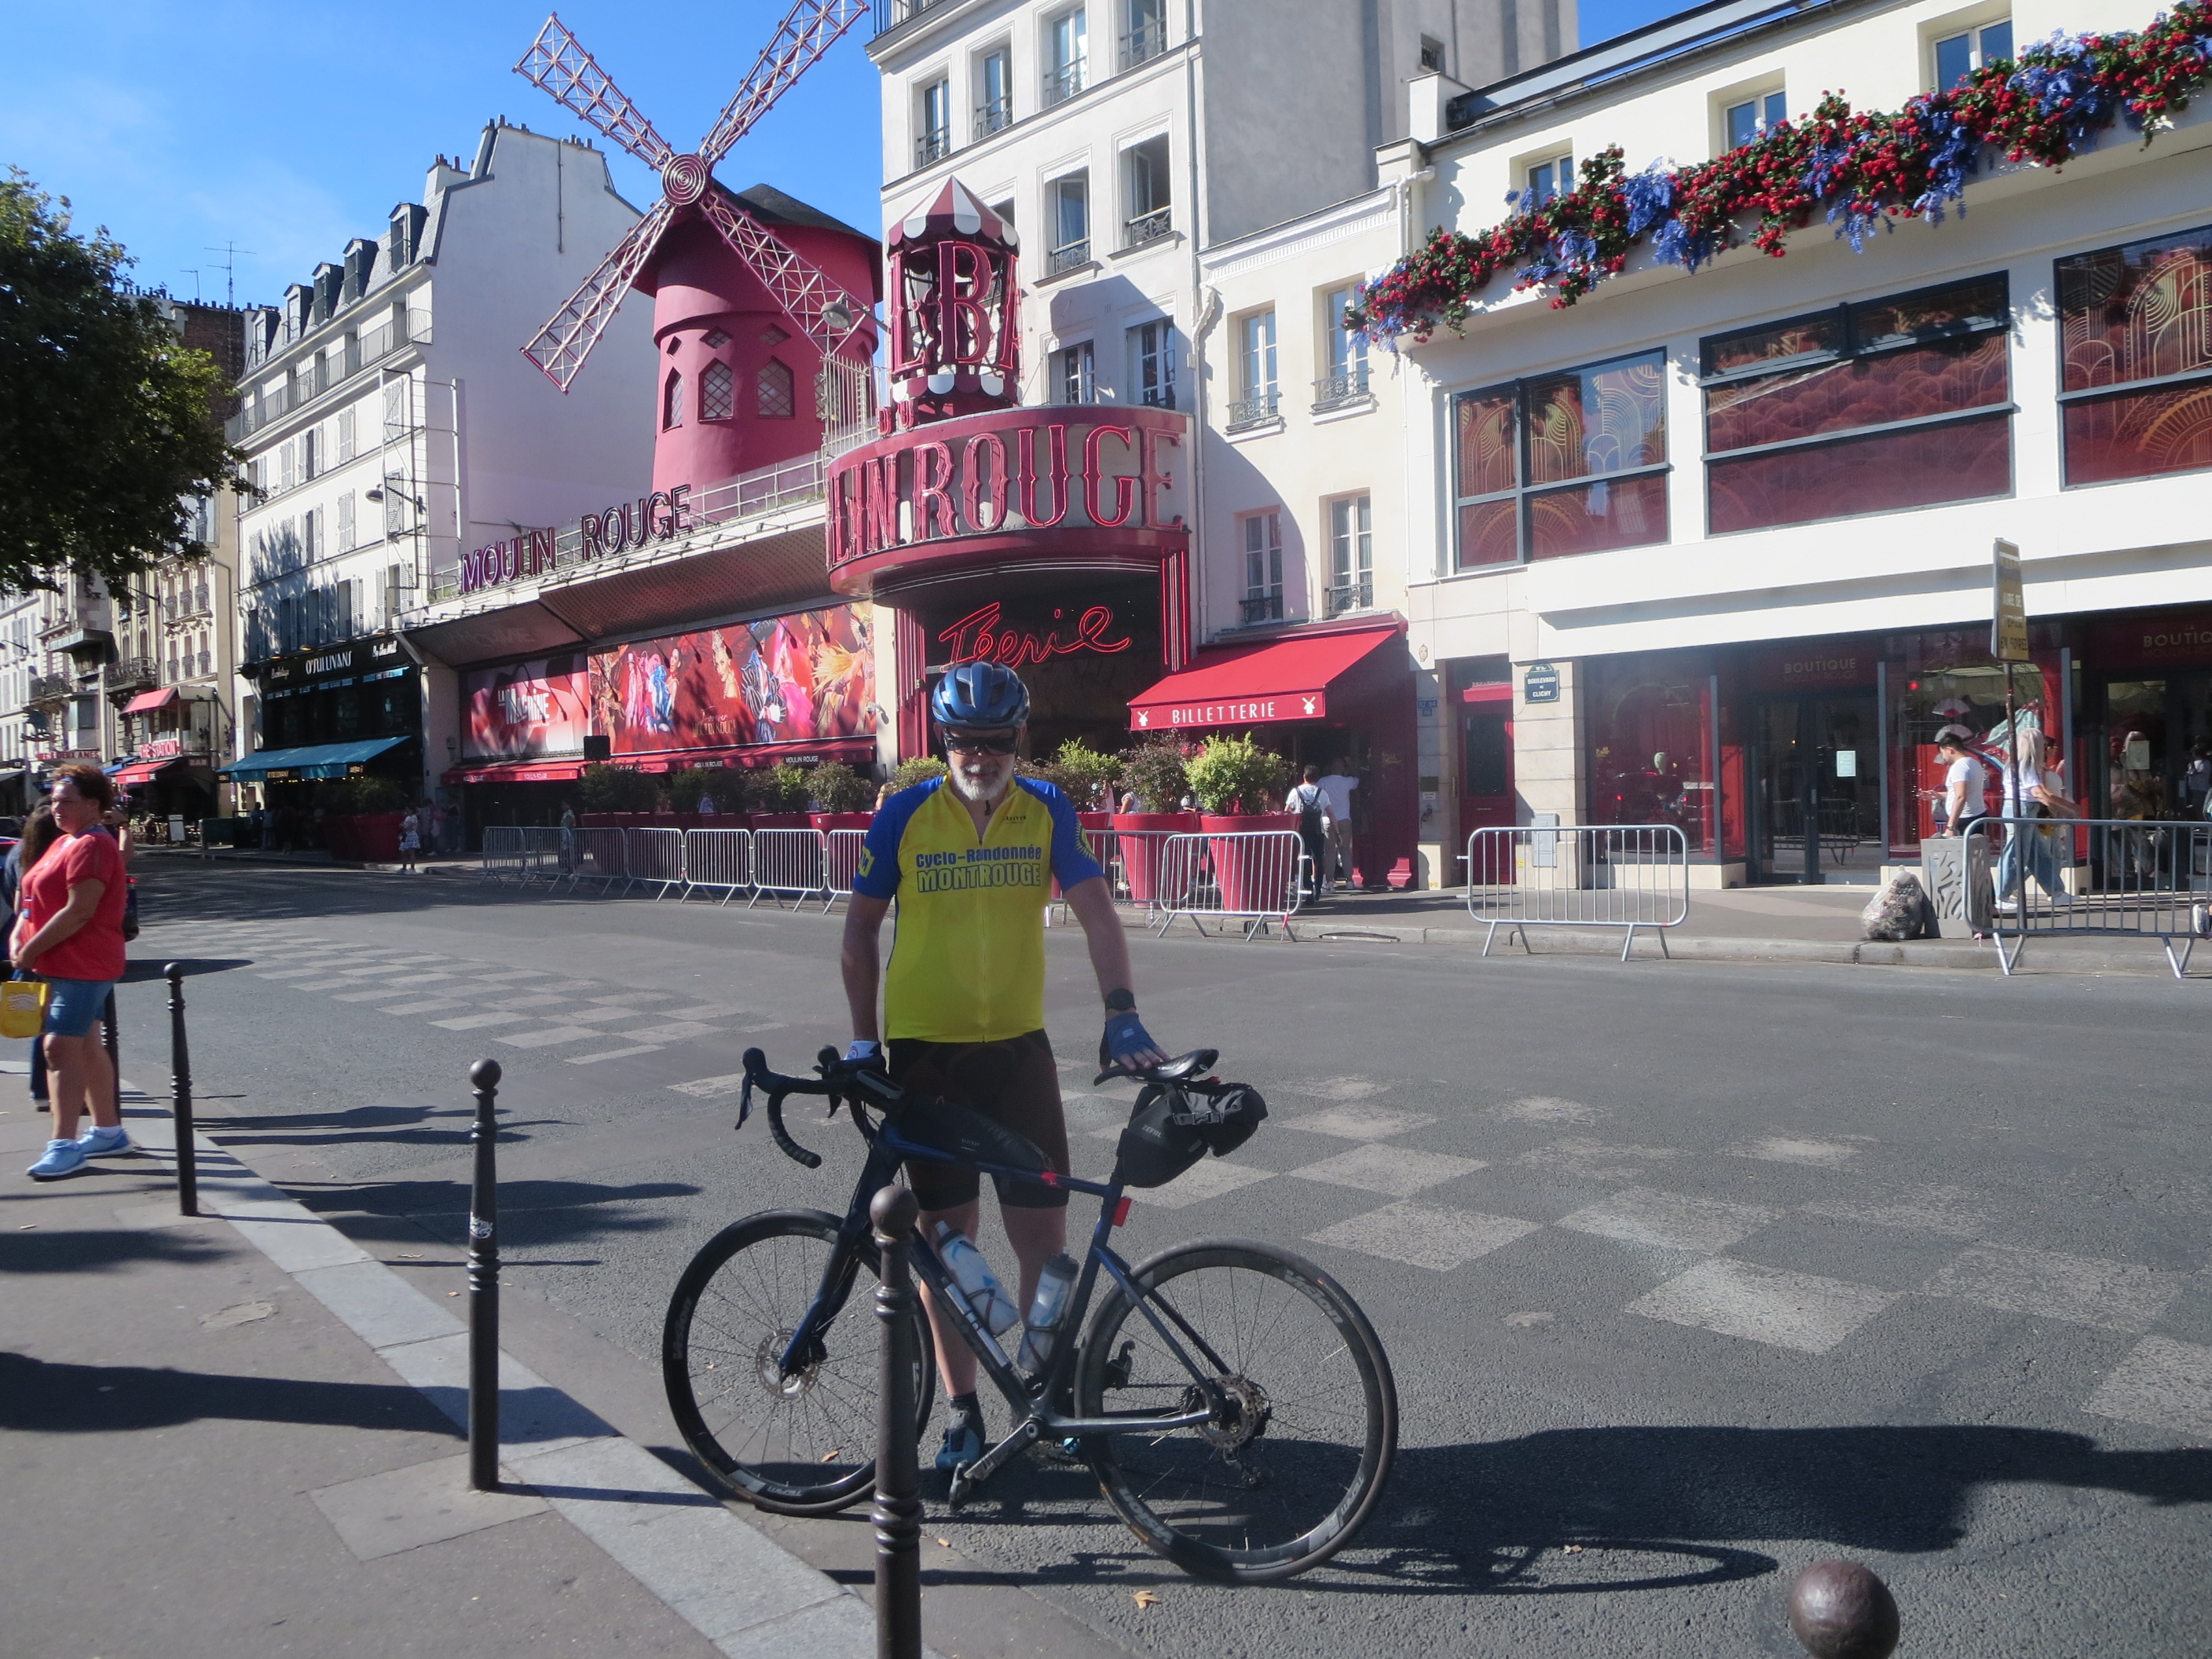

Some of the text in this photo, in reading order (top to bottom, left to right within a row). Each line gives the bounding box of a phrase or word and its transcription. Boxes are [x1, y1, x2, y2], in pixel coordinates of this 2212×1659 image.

[913, 424, 1185, 542] ROUGE
[462, 484, 694, 592] MOULIN ROUGE
[306, 650, 353, 675] O'SULLIVANS
[1785, 658, 1856, 674] BOUTIQUE
[1527, 676, 1556, 685] BOULEVARD
[189, 759, 207, 767] BAR
[916, 844, 1042, 868] Cyclo-Randonnée
[917, 862, 1041, 893] MONTROUGE
